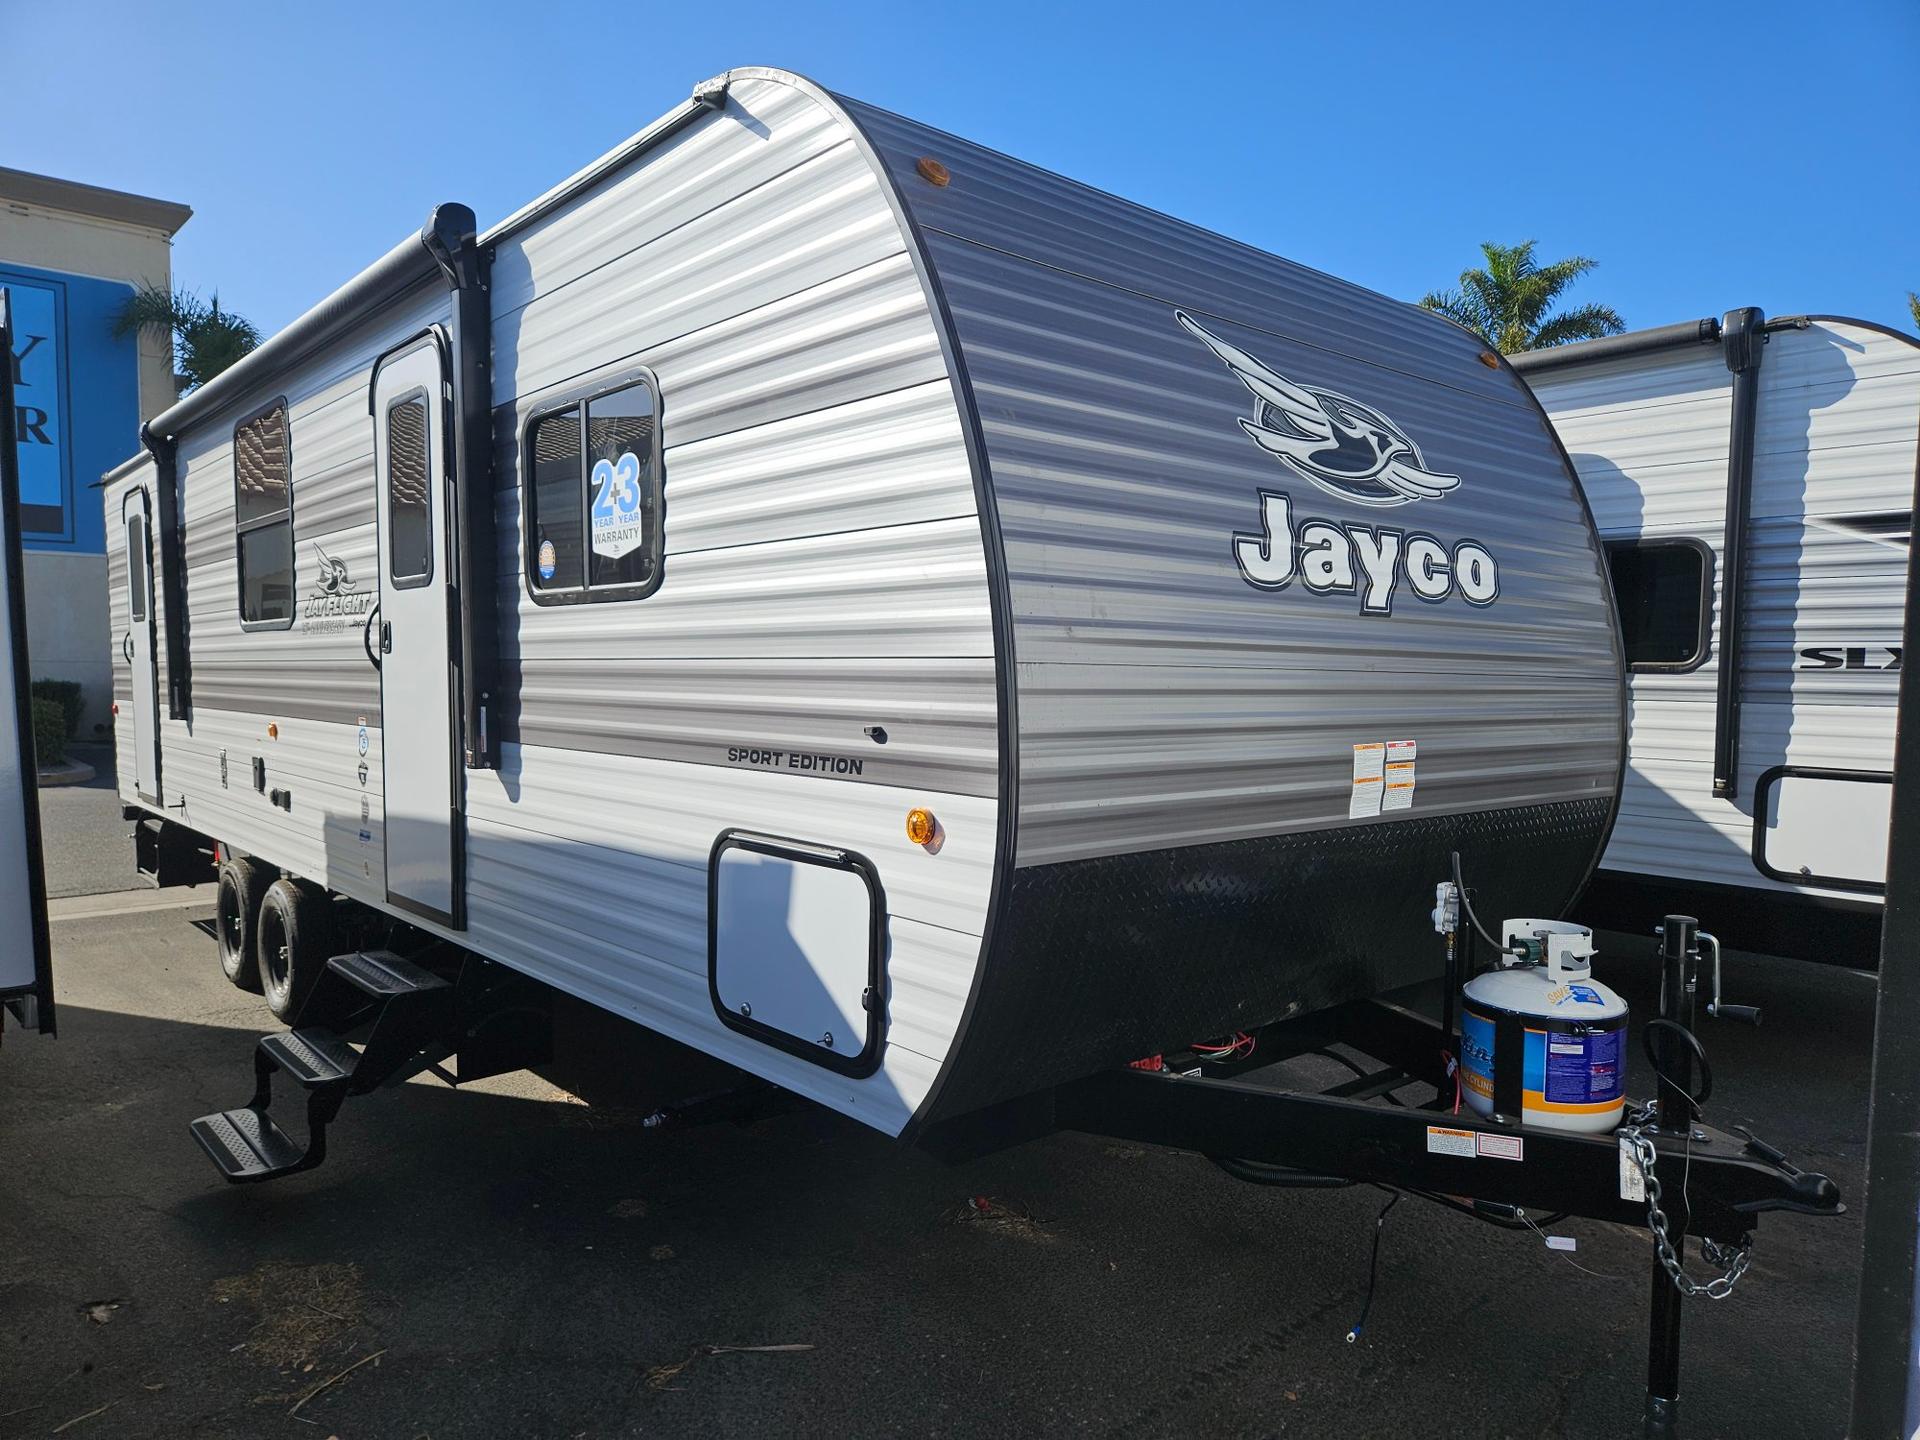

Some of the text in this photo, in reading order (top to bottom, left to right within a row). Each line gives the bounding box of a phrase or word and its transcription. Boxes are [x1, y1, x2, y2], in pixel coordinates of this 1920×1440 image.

[594, 512, 640, 528] YEAR YEAR
[594, 527, 639, 544] WARRANTY
[1232, 487, 1500, 618] Jayco
[728, 747, 863, 775] SPORT EDITION
